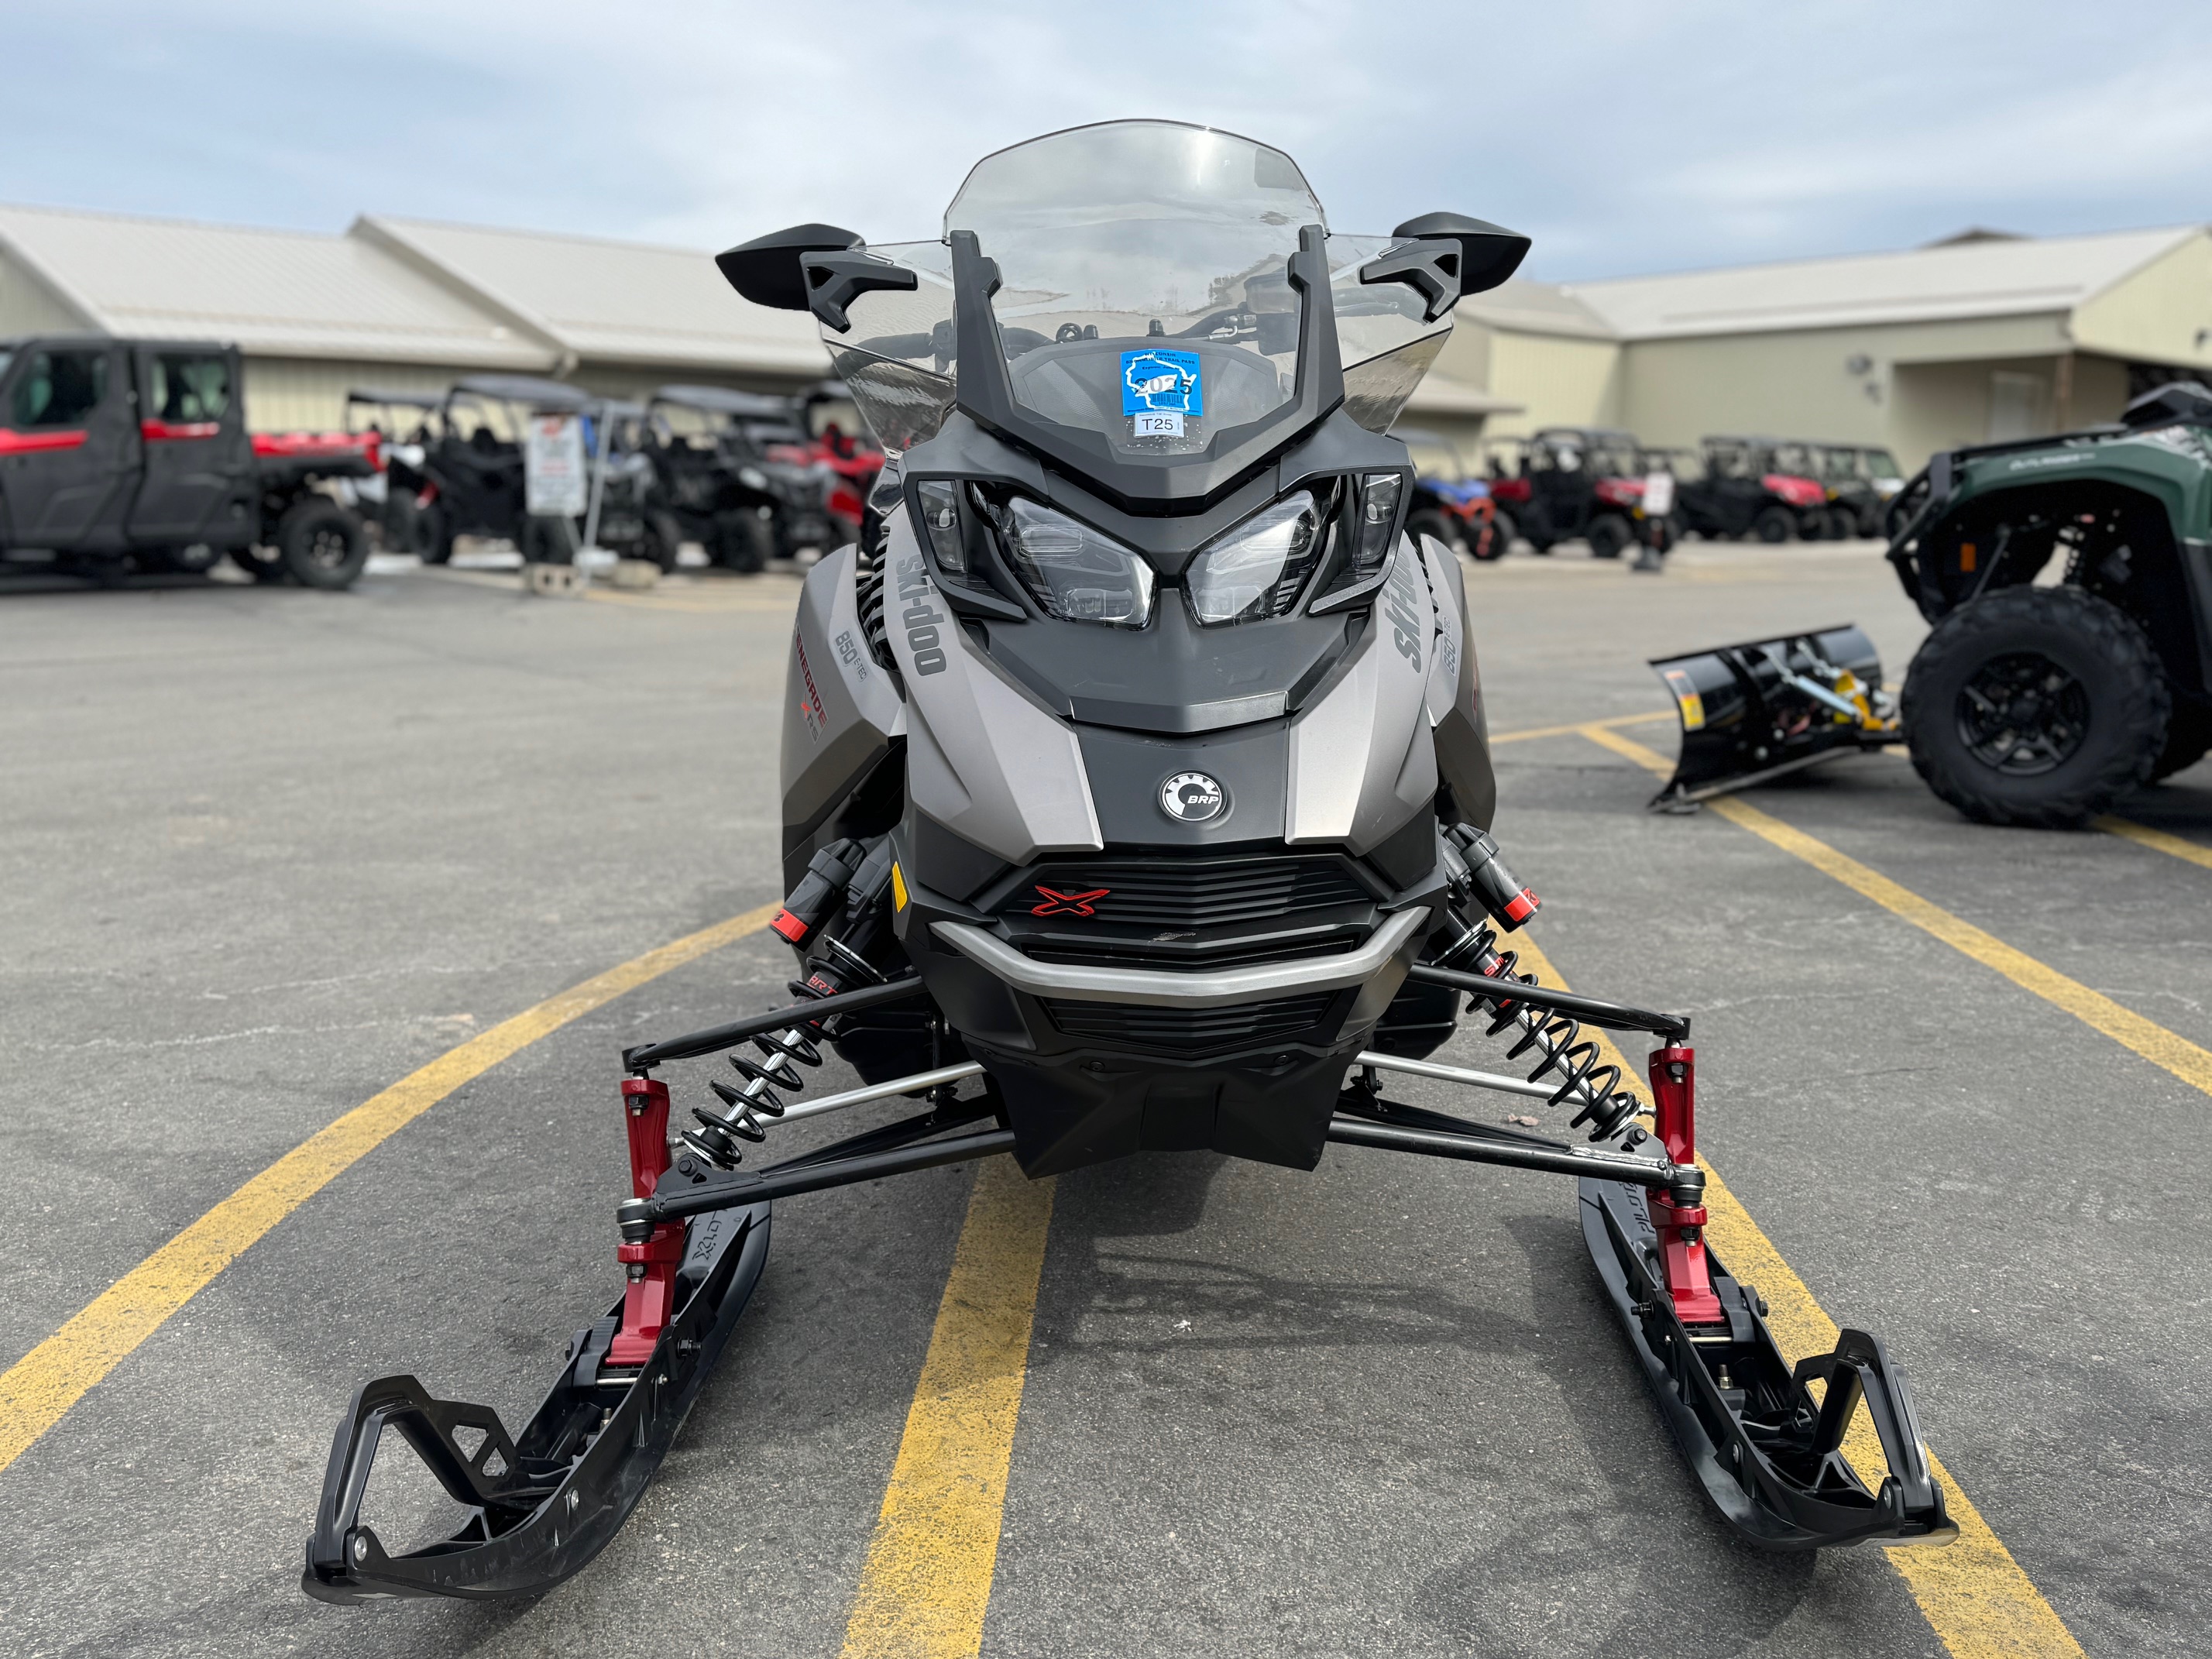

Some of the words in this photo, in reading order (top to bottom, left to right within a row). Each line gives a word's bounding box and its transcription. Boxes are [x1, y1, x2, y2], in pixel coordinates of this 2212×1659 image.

[1135, 377, 1193, 395] 2025
[1142, 418, 1173, 431] T25
[835, 630, 858, 665] 850
[854, 657, 867, 680] E-TEC
[1443, 637, 1457, 675] 850
[1187, 795, 1219, 805] BRP
[809, 975, 838, 995] ART
